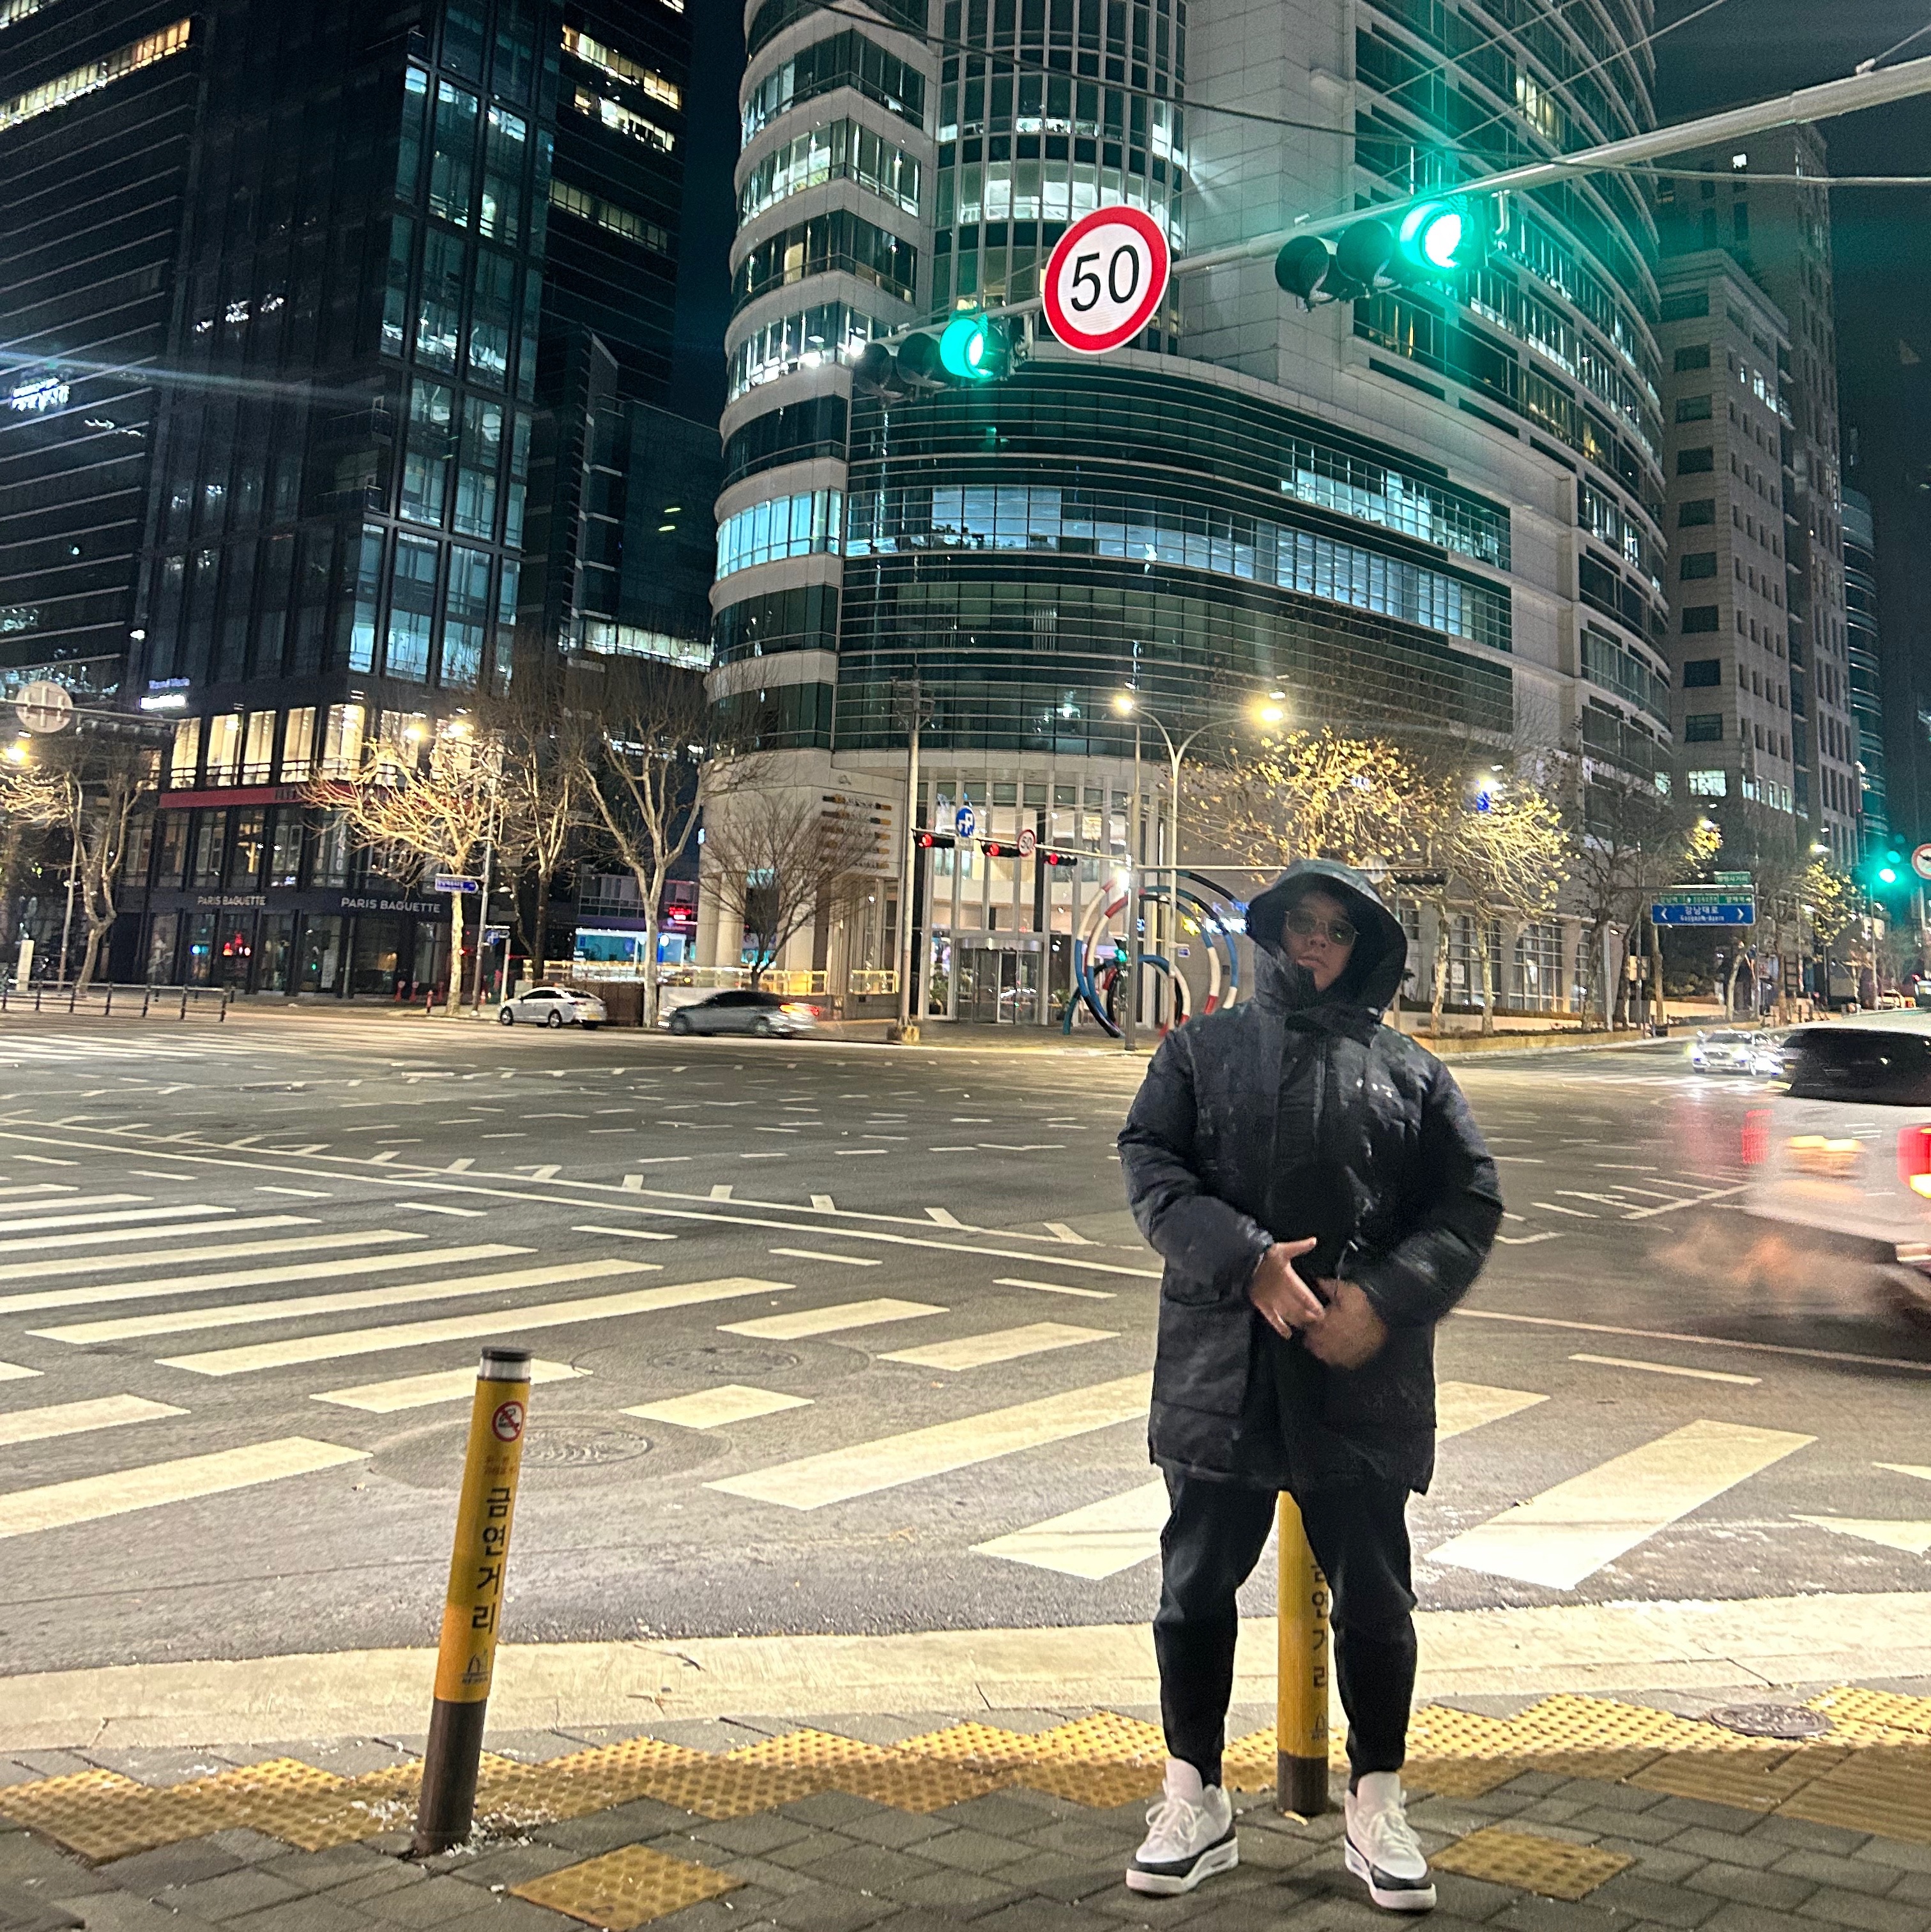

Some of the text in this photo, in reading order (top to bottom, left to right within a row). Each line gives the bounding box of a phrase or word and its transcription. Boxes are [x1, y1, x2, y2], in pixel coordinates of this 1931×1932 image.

[1071, 244, 1140, 312] 50
[197, 896, 266, 906] PARIS BAGUETTE
[341, 897, 441, 913] PARIS BAGUETTE
[1685, 906, 1719, 915] 강남대로
[471, 1487, 510, 1634] 금연거리
